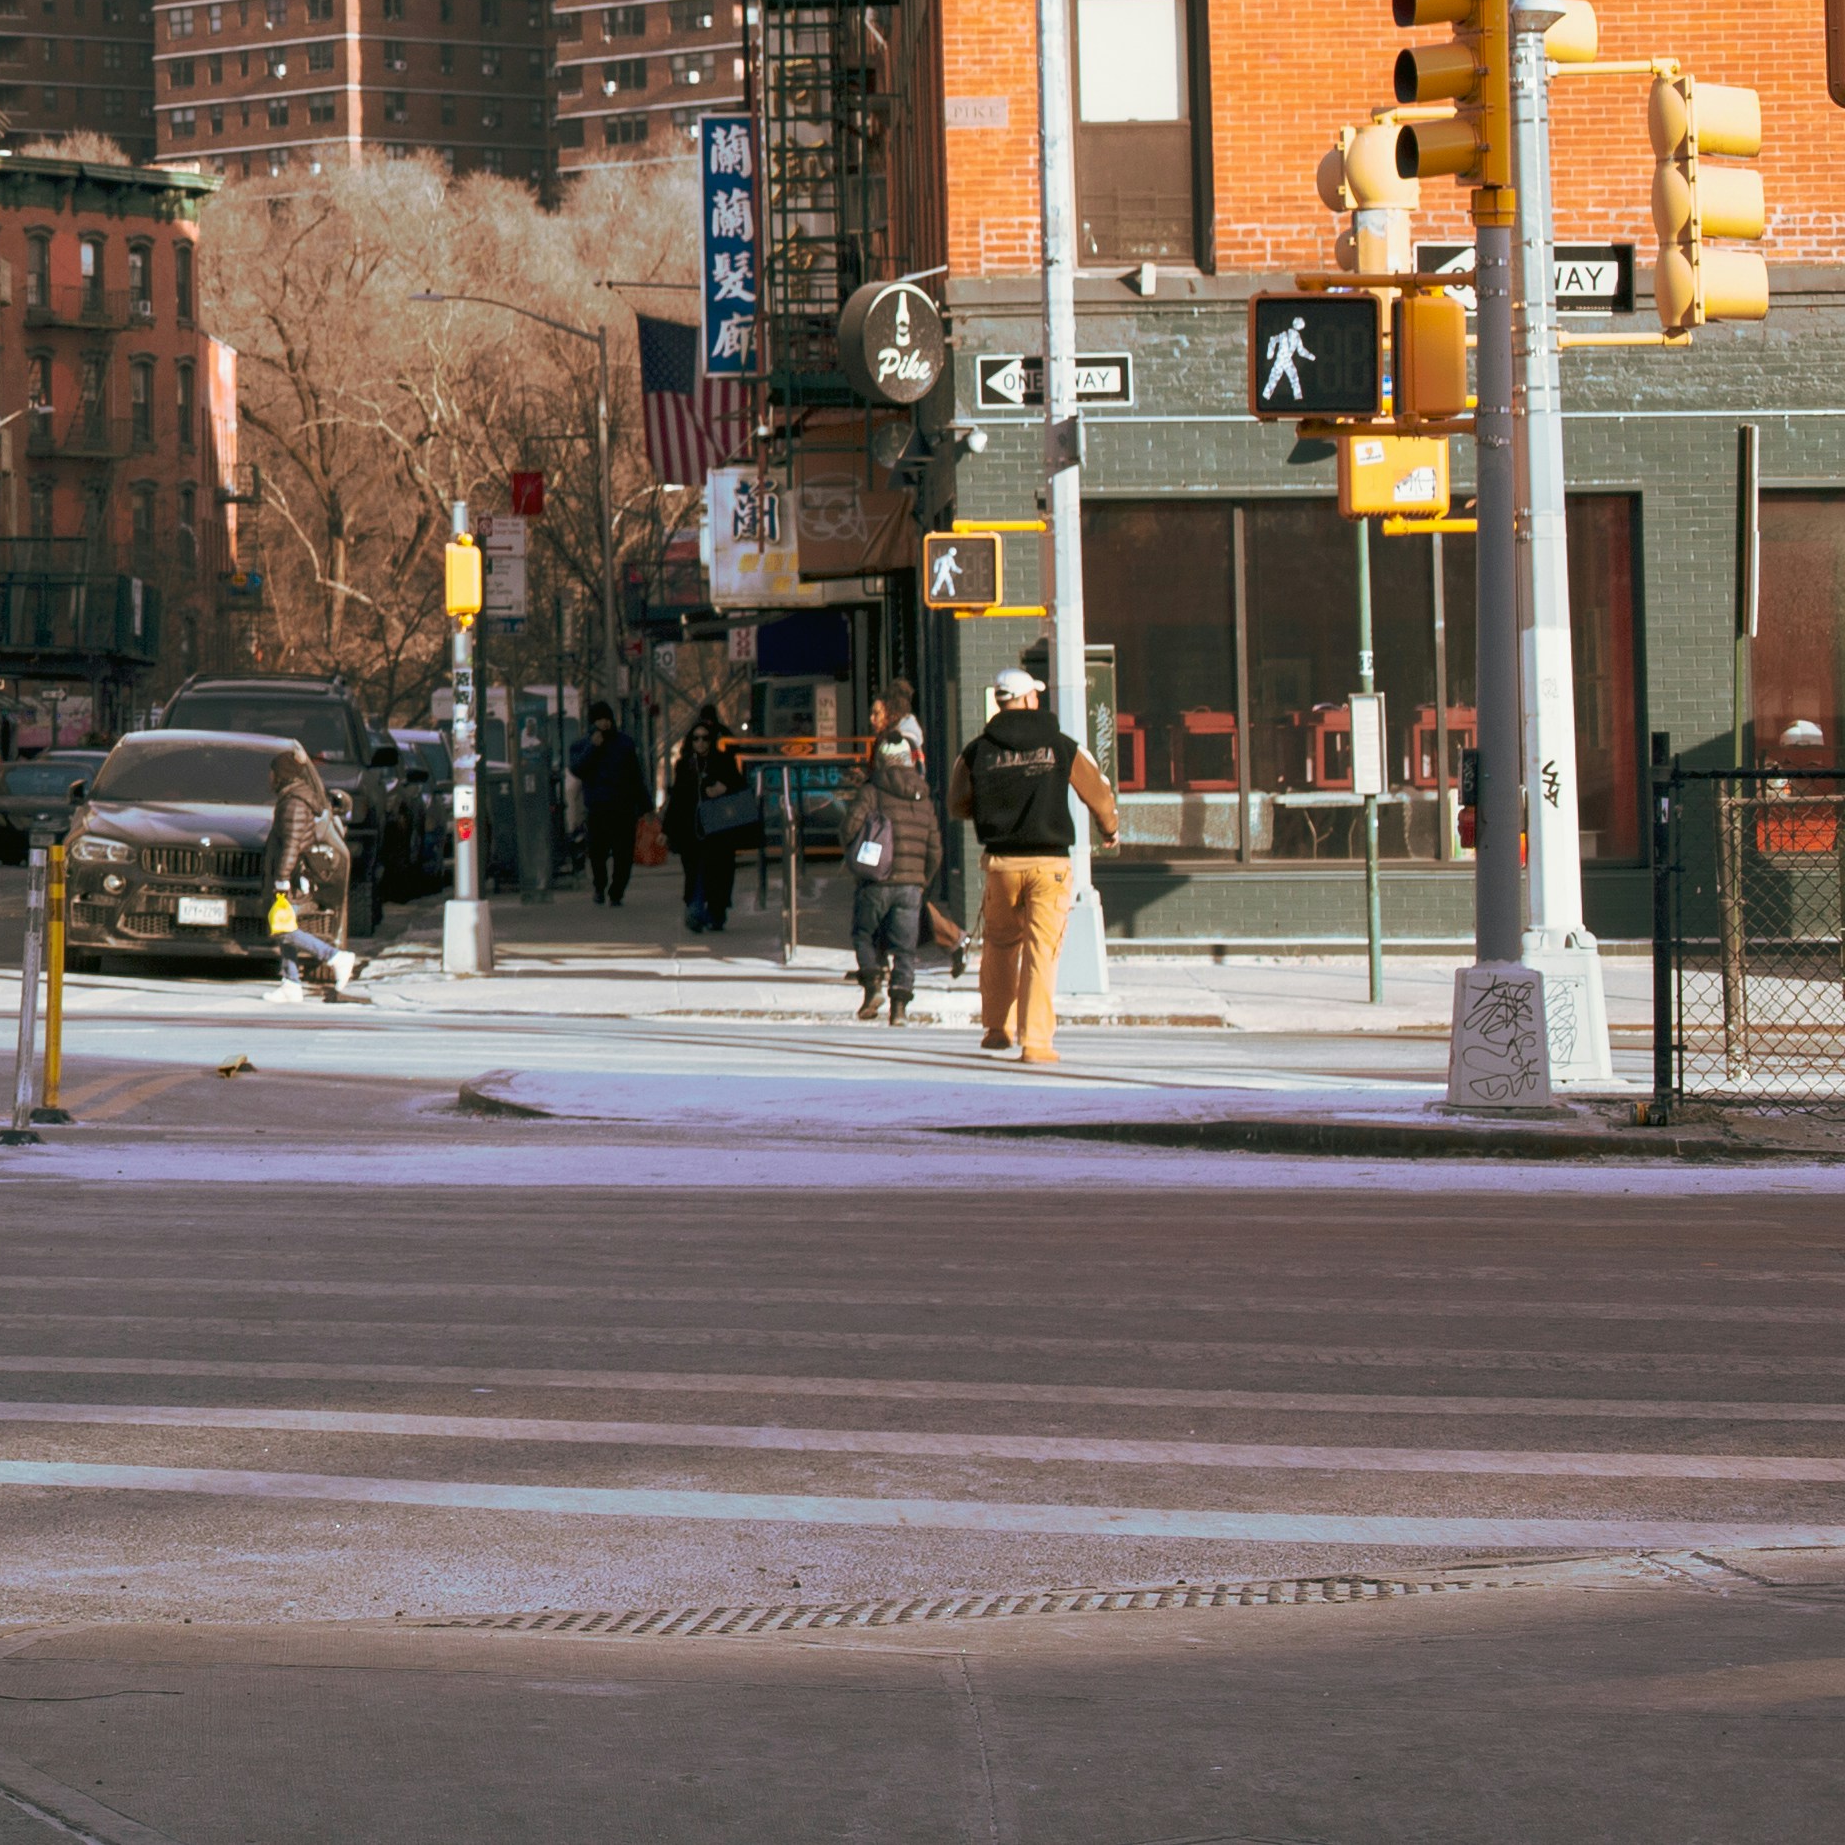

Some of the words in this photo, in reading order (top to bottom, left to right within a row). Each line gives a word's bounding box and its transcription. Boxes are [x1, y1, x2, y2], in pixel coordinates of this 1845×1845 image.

[953, 103, 1000, 121] PIKE
[877, 347, 933, 384] Pike
[1002, 369, 1045, 393] ONE
